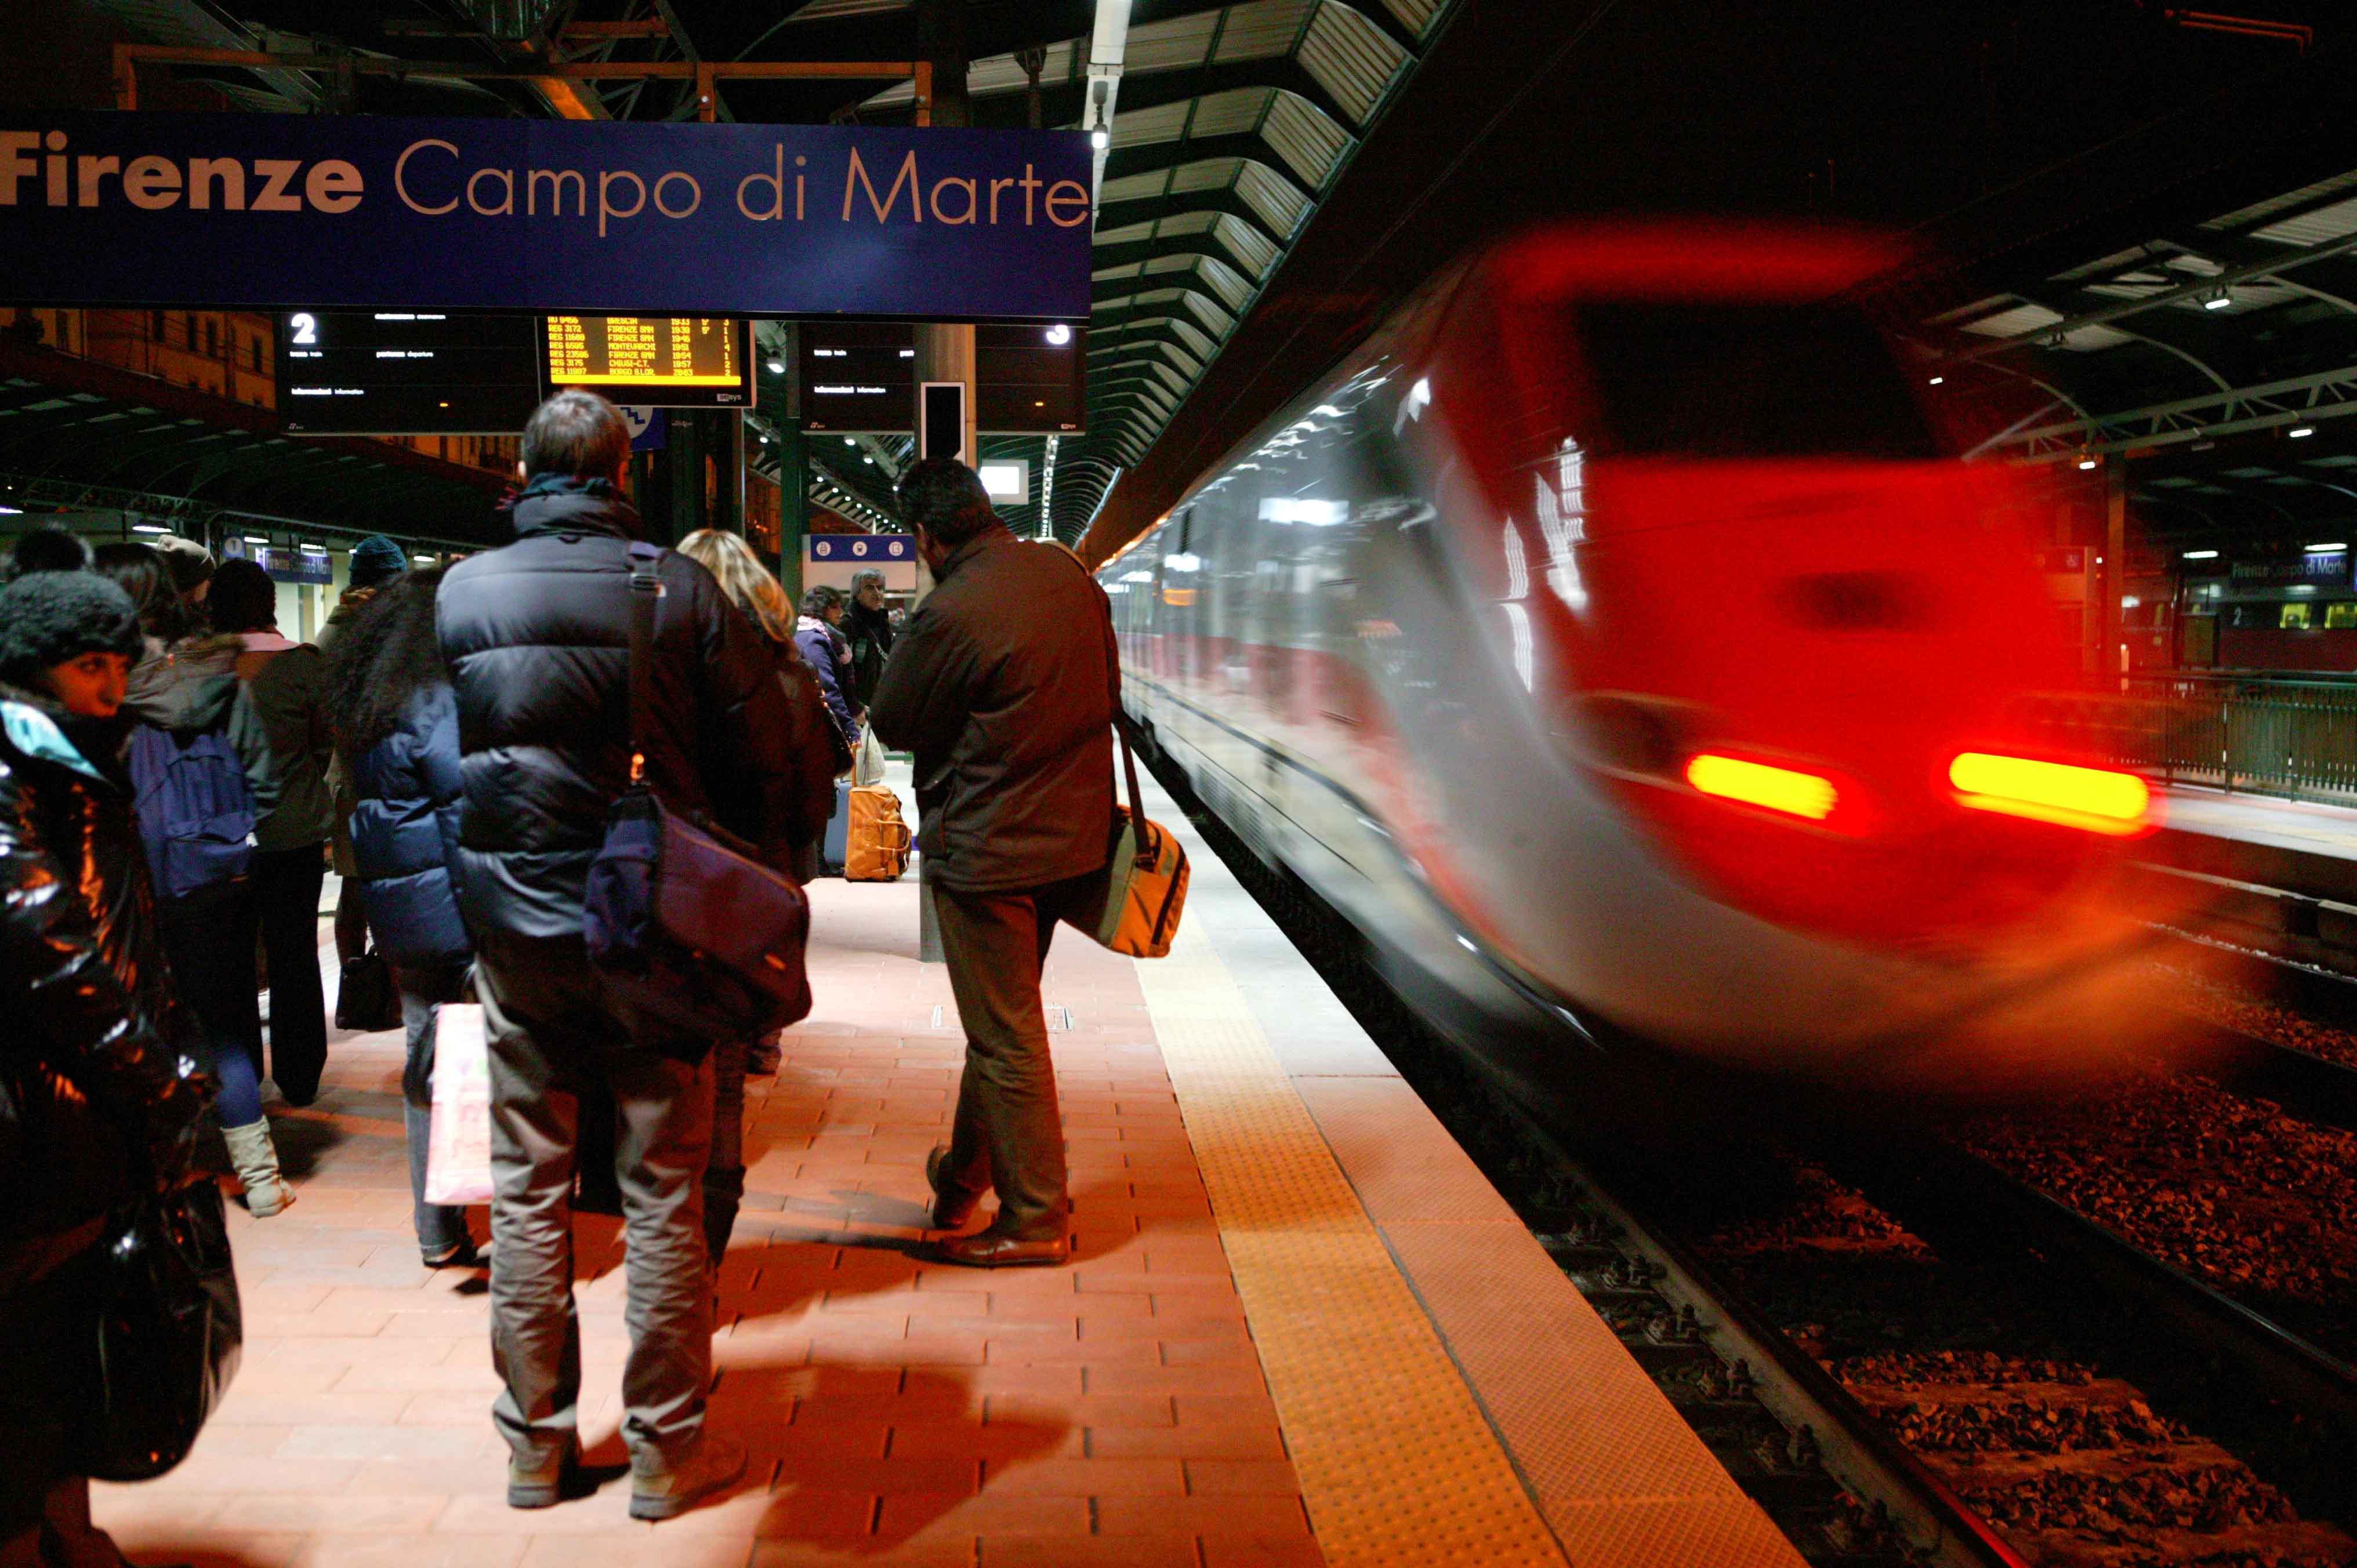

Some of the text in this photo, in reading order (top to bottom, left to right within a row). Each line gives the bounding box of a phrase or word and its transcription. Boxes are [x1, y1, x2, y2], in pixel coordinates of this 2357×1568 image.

[0, 130, 1090, 237] Firenze Campo di Marte
[291, 313, 316, 343] 2
[548, 324, 563, 332] REG
[564, 325, 582, 333] 3172
[549, 333, 563, 341] REG
[725, 361, 730, 369] 2
